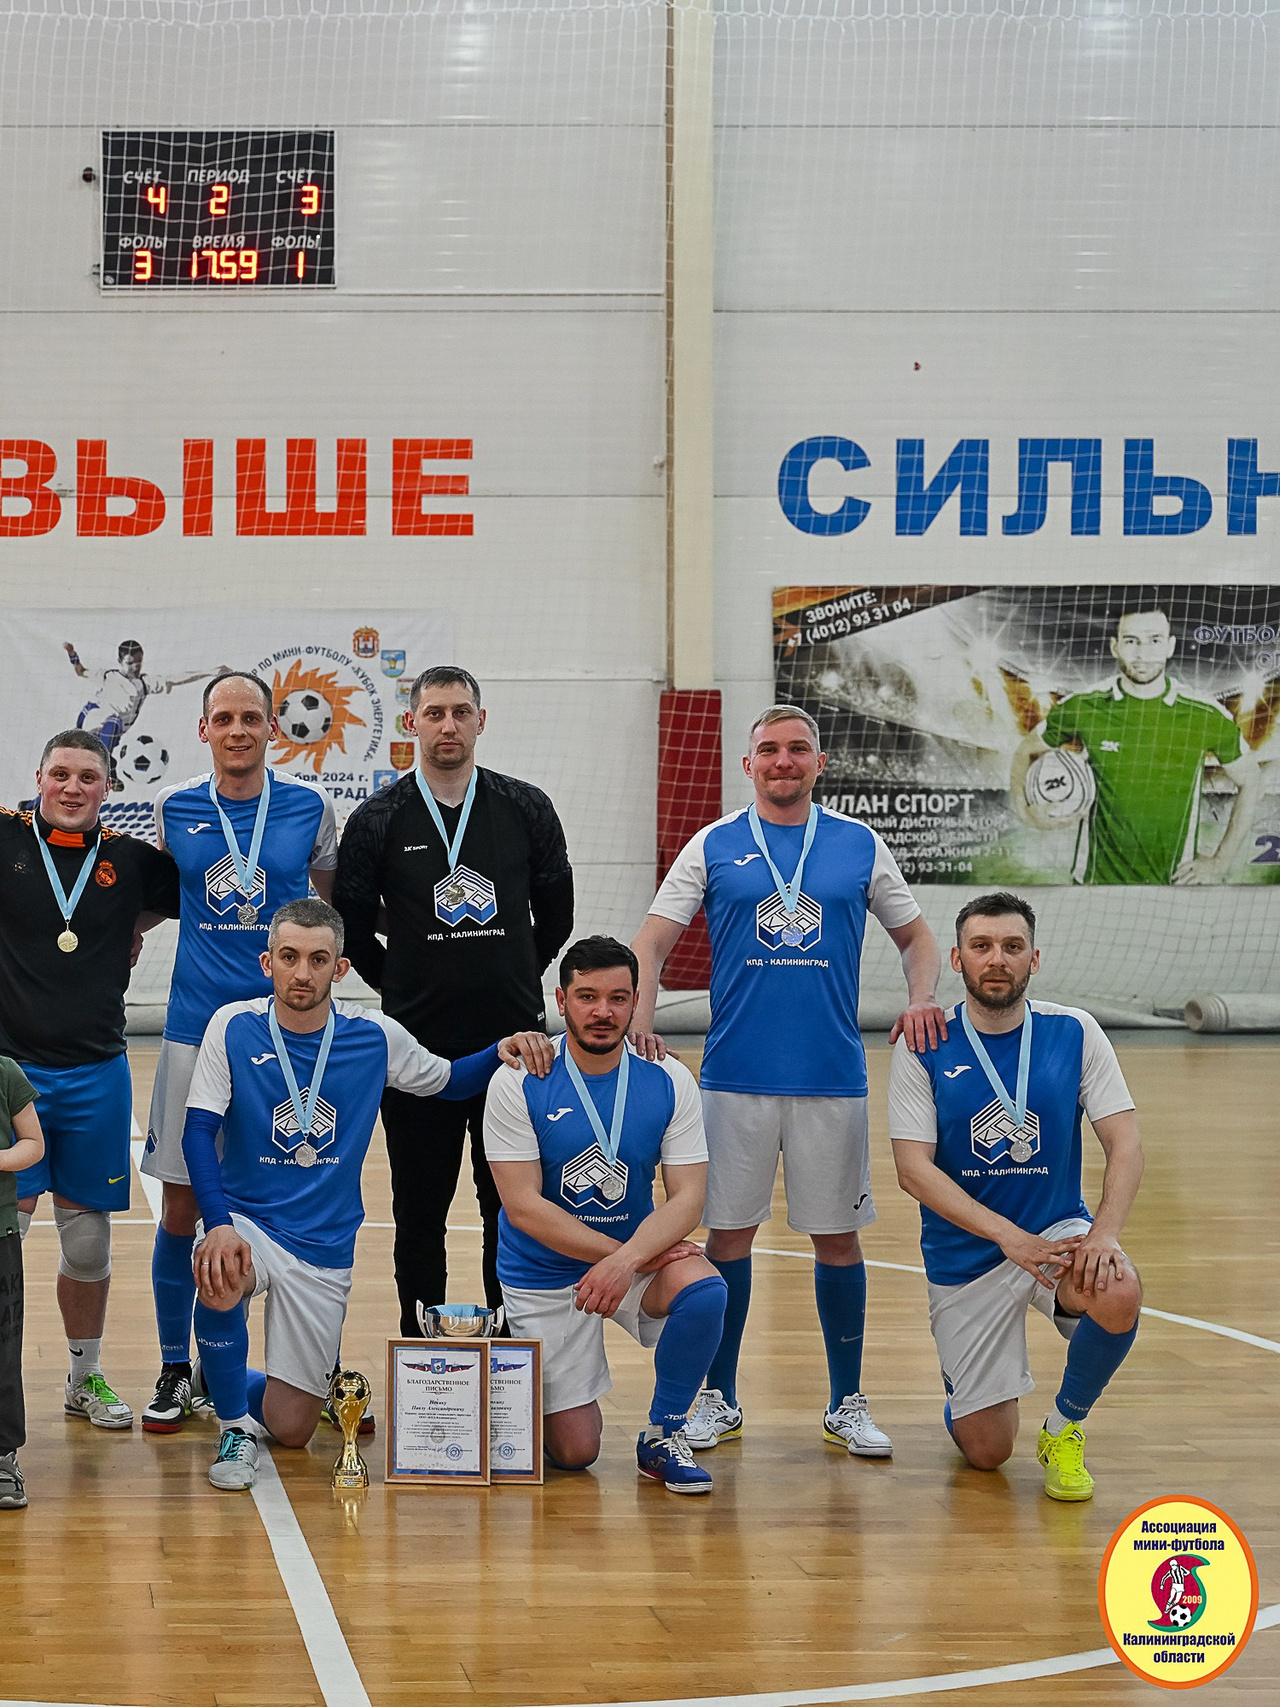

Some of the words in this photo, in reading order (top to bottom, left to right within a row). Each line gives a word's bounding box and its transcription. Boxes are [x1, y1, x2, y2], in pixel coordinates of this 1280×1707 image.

[187, 169, 250, 183] ПЕРИОД
[147, 186, 166, 214] 4
[209, 185, 228, 214] 2
[301, 185, 318, 214] 3
[119, 236, 167, 249] ФОЛЫ
[193, 235, 245, 248] ВРЕМЯ
[271, 236, 320, 249] ФОЛЫ
[135, 250, 152, 279] 3
[297, 251, 304, 278] 1
[805, 591, 877, 623] ЗВОНИТЕ:
[806, 617, 850, 645] (4012)
[852, 611, 871, 626] 93
[872, 604, 890, 620] 31
[892, 597, 911, 613] 04
[1193, 626, 1280, 644] ФУТБО
[258, 658, 272, 671] ПО
[294, 772, 317, 782] бря
[322, 772, 354, 782] 2024
[358, 774, 369, 782] г.
[822, 794, 888, 813] ИЛАН
[895, 794, 975, 815] СПОРТ
[881, 830, 937, 844] РАДСКОЙ
[199, 923, 213, 931] КПД
[218, 923, 271, 931] КАЛИНИНГРА
[427, 933, 444, 941] КПД
[451, 929, 505, 939] КАЛИНИНГРАД
[747, 959, 763, 967] КПД
[770, 959, 829, 968] КАЛИНИНГРАД
[260, 1157, 276, 1165] КПД
[962, 1170, 980, 1178] КПД
[988, 1167, 1049, 1177] КАЛИНИНГРАД
